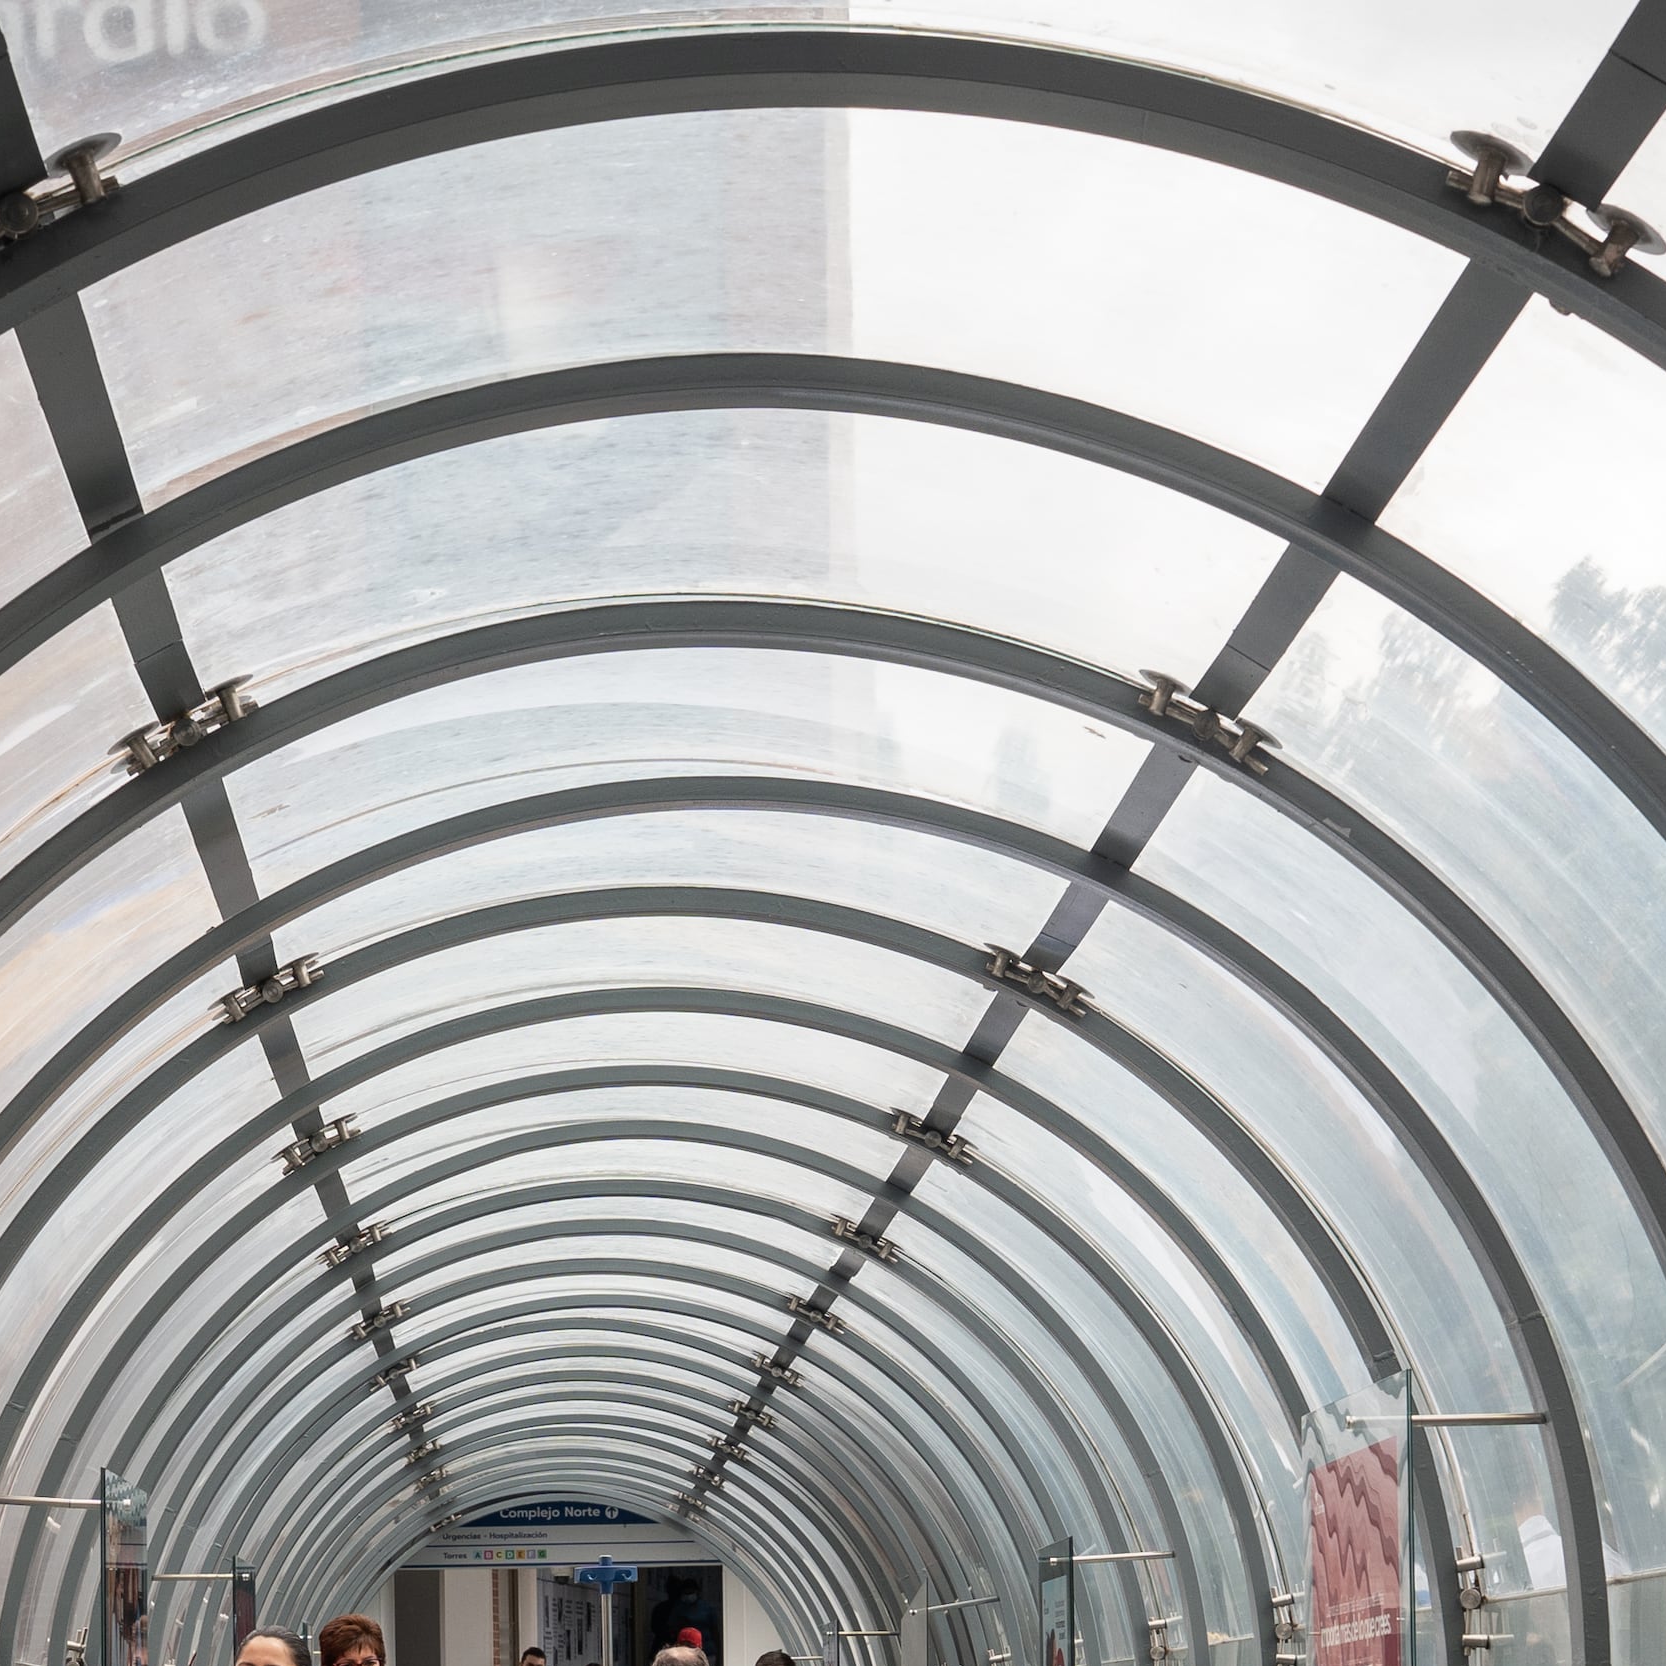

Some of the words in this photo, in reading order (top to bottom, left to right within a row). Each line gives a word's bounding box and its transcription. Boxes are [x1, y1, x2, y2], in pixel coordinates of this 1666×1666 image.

[500, 1506, 560, 1520] Complejo
[565, 1506, 600, 1518] Norte
[442, 1531, 481, 1541] Urgencias
[489, 1531, 548, 1541] Hospitalización
[443, 1551, 467, 1560] Torres
